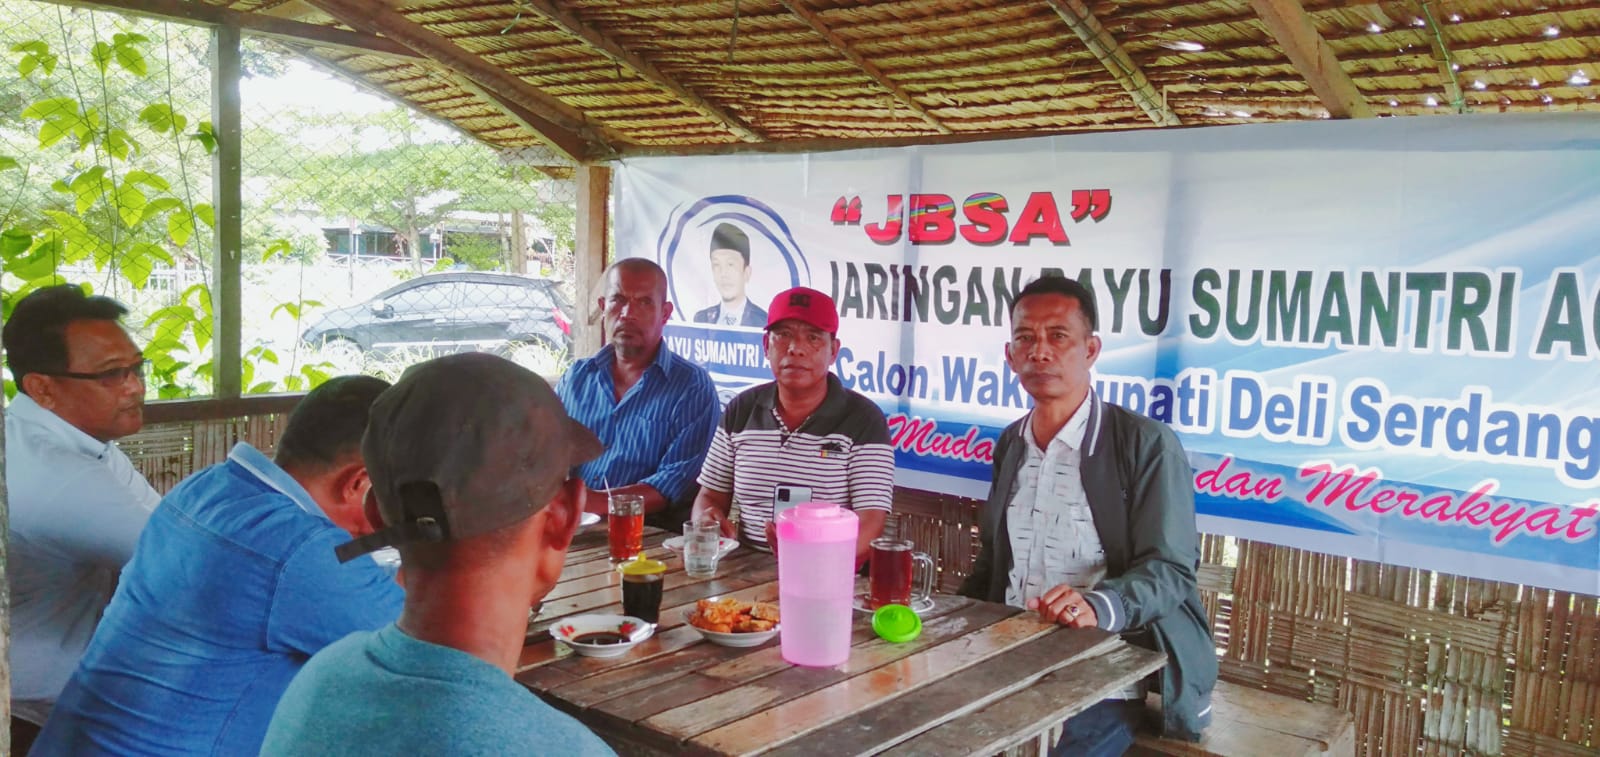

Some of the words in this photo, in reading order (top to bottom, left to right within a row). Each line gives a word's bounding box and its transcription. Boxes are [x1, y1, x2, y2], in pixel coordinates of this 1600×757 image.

[663, 335, 692, 361] AYU
[694, 338, 760, 369] SUMANTRI
[1040, 267, 1171, 336] AYU
[1188, 267, 1516, 353] SUMANTRI
[1535, 272, 1600, 357] A
[835, 346, 928, 399] Calon
[1090, 369, 1209, 428] upati
[1228, 376, 1328, 438] Deli
[1346, 384, 1600, 481] Serdang
[1195, 457, 1284, 500] dan
[1300, 463, 1600, 542] Merakyat
